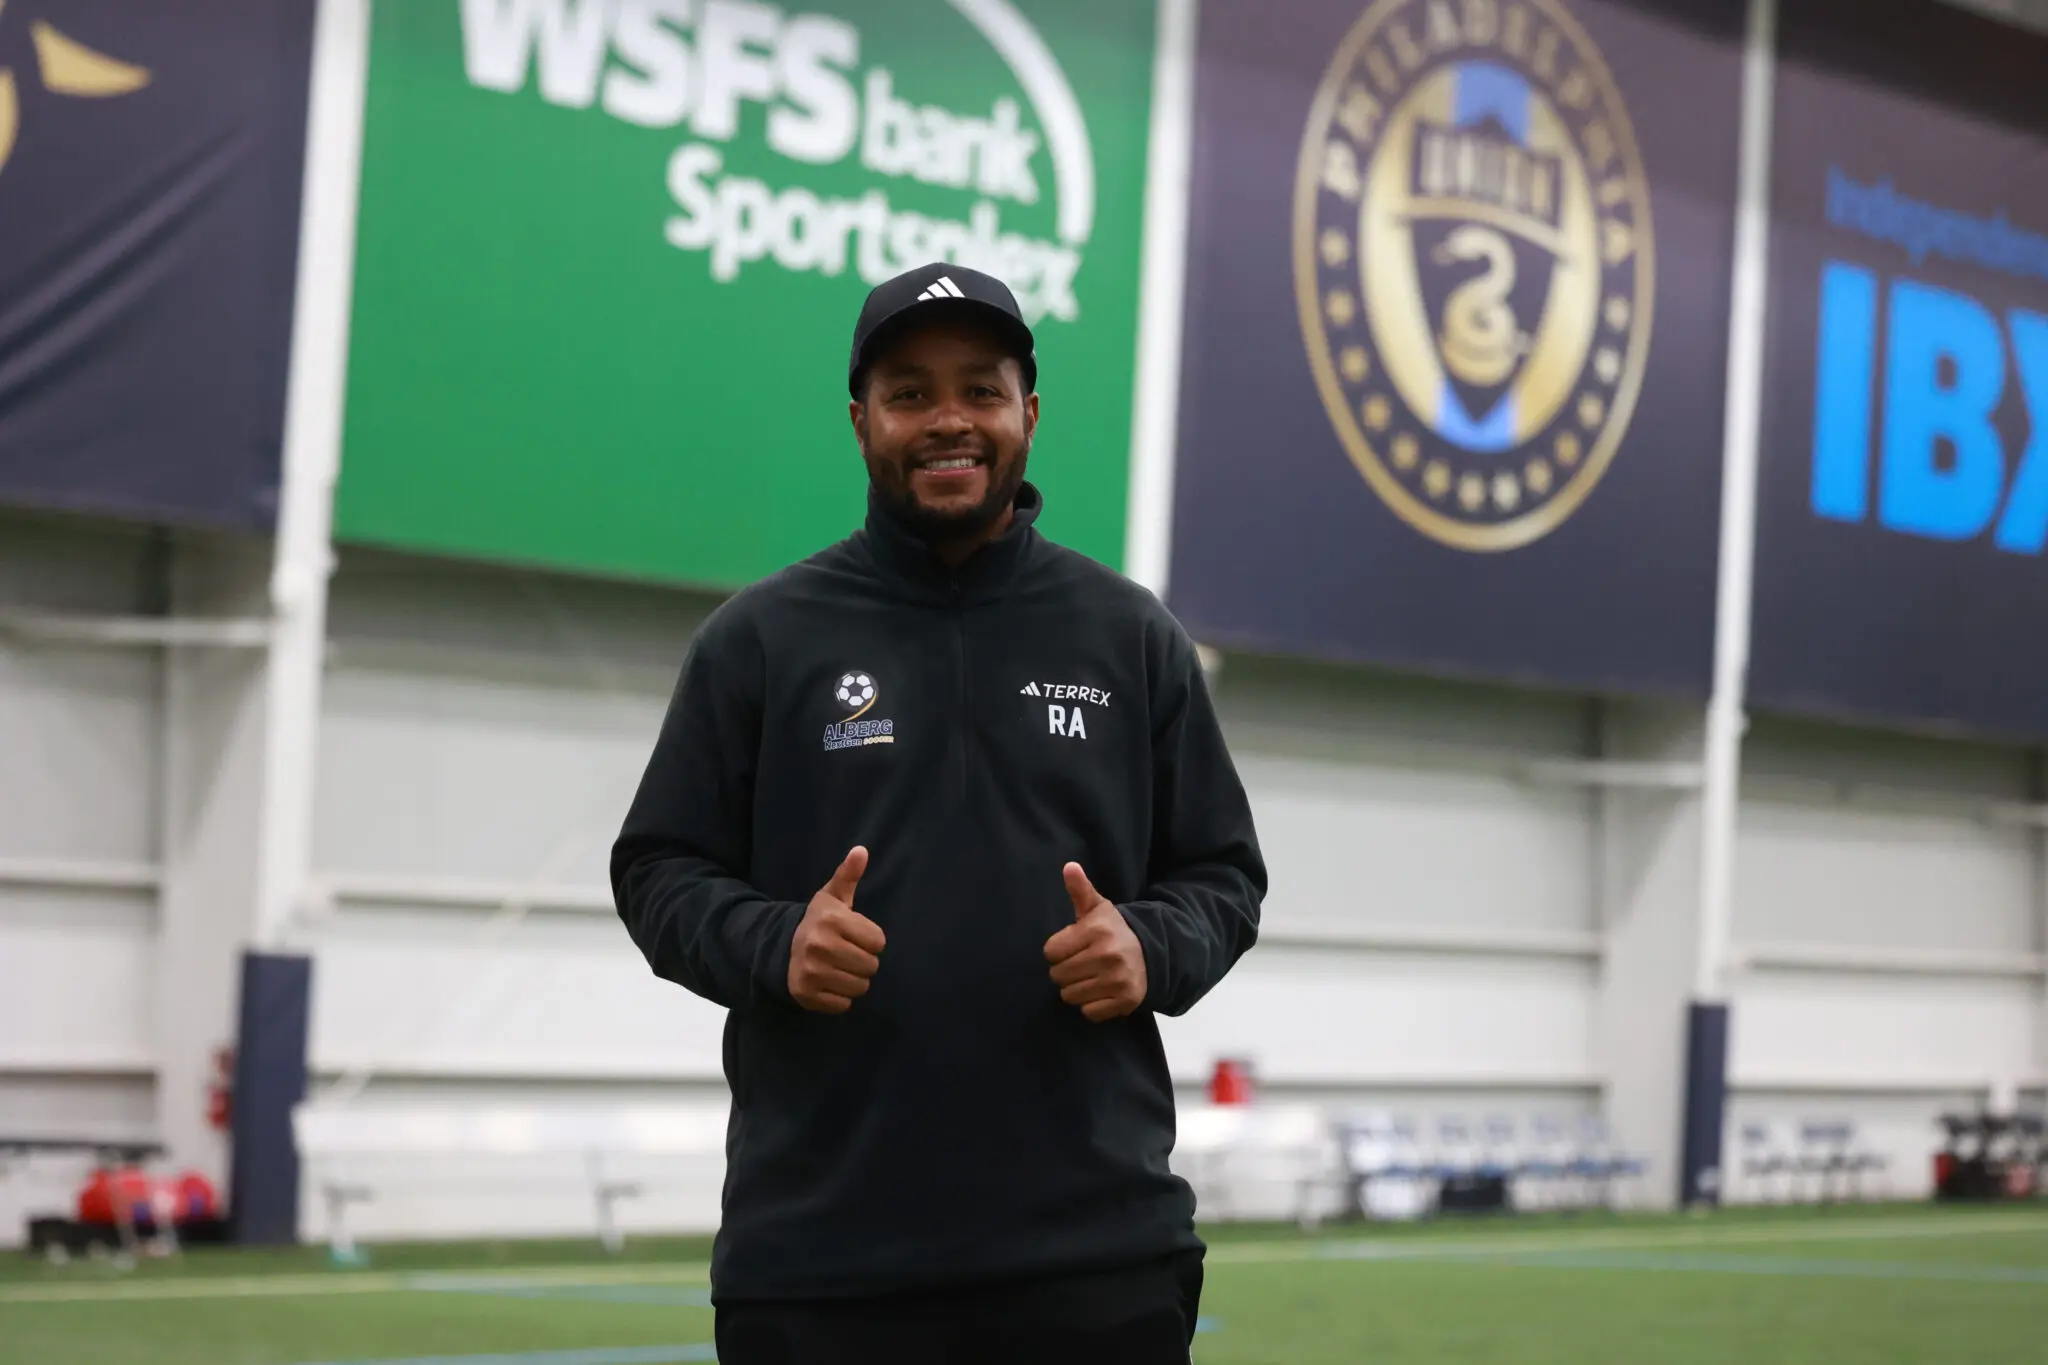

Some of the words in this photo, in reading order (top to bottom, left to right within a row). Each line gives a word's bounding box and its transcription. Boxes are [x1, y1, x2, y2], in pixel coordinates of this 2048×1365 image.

[459, 0, 860, 164] WSFS
[861, 68, 1041, 204] bank
[1043, 683, 1111, 707] TERREX
[823, 719, 893, 742] ALBERG
[1048, 704, 1087, 739] RA
